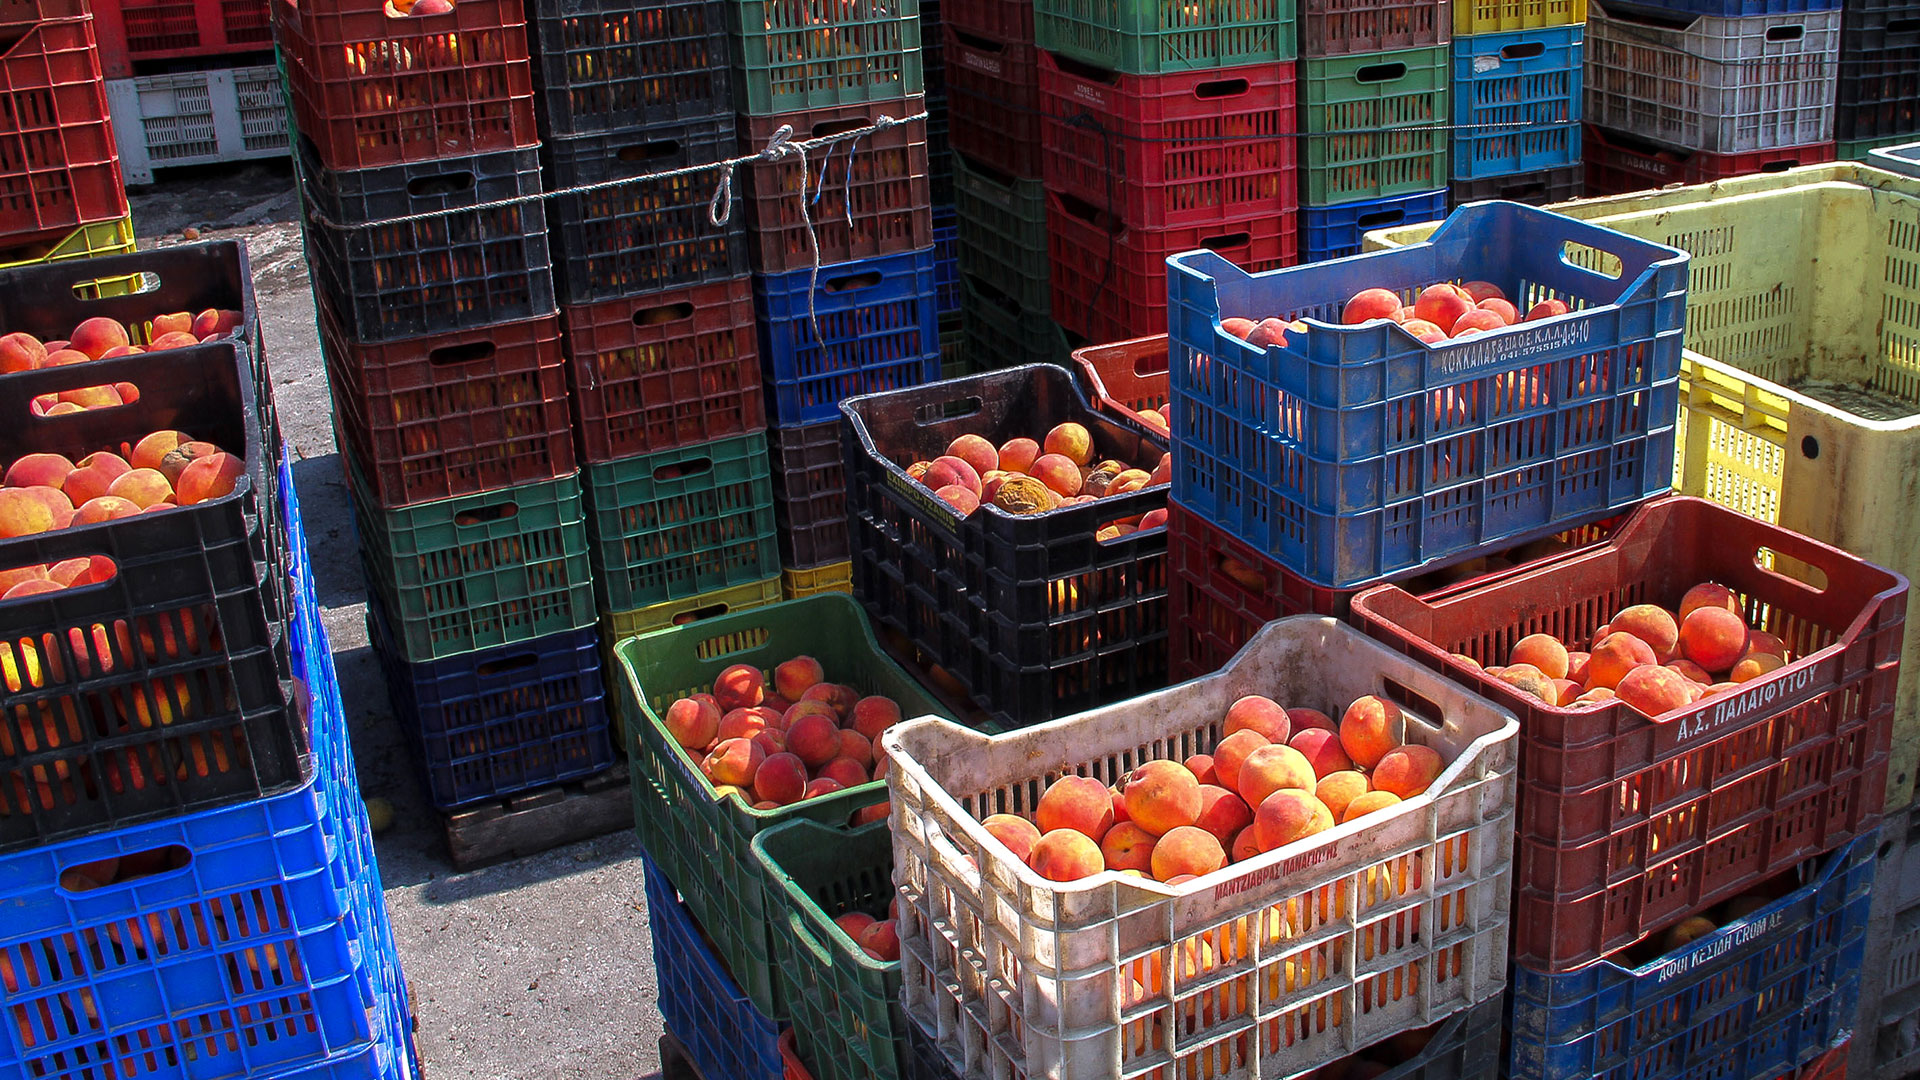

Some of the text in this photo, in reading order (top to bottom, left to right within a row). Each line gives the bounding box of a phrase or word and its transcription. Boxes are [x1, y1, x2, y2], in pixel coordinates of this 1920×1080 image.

[1440, 340, 1497, 375] ΚΟΚΚΑΛΑΣ
[1500, 340, 1561, 361] 041-575515
[1677, 664, 1817, 742] Α.Σ. ΠΑΛΑΙΦΥΤΟΥ
[1214, 863, 1281, 902] ΜΑΝΤΖΙΑΒΡΑΣ
